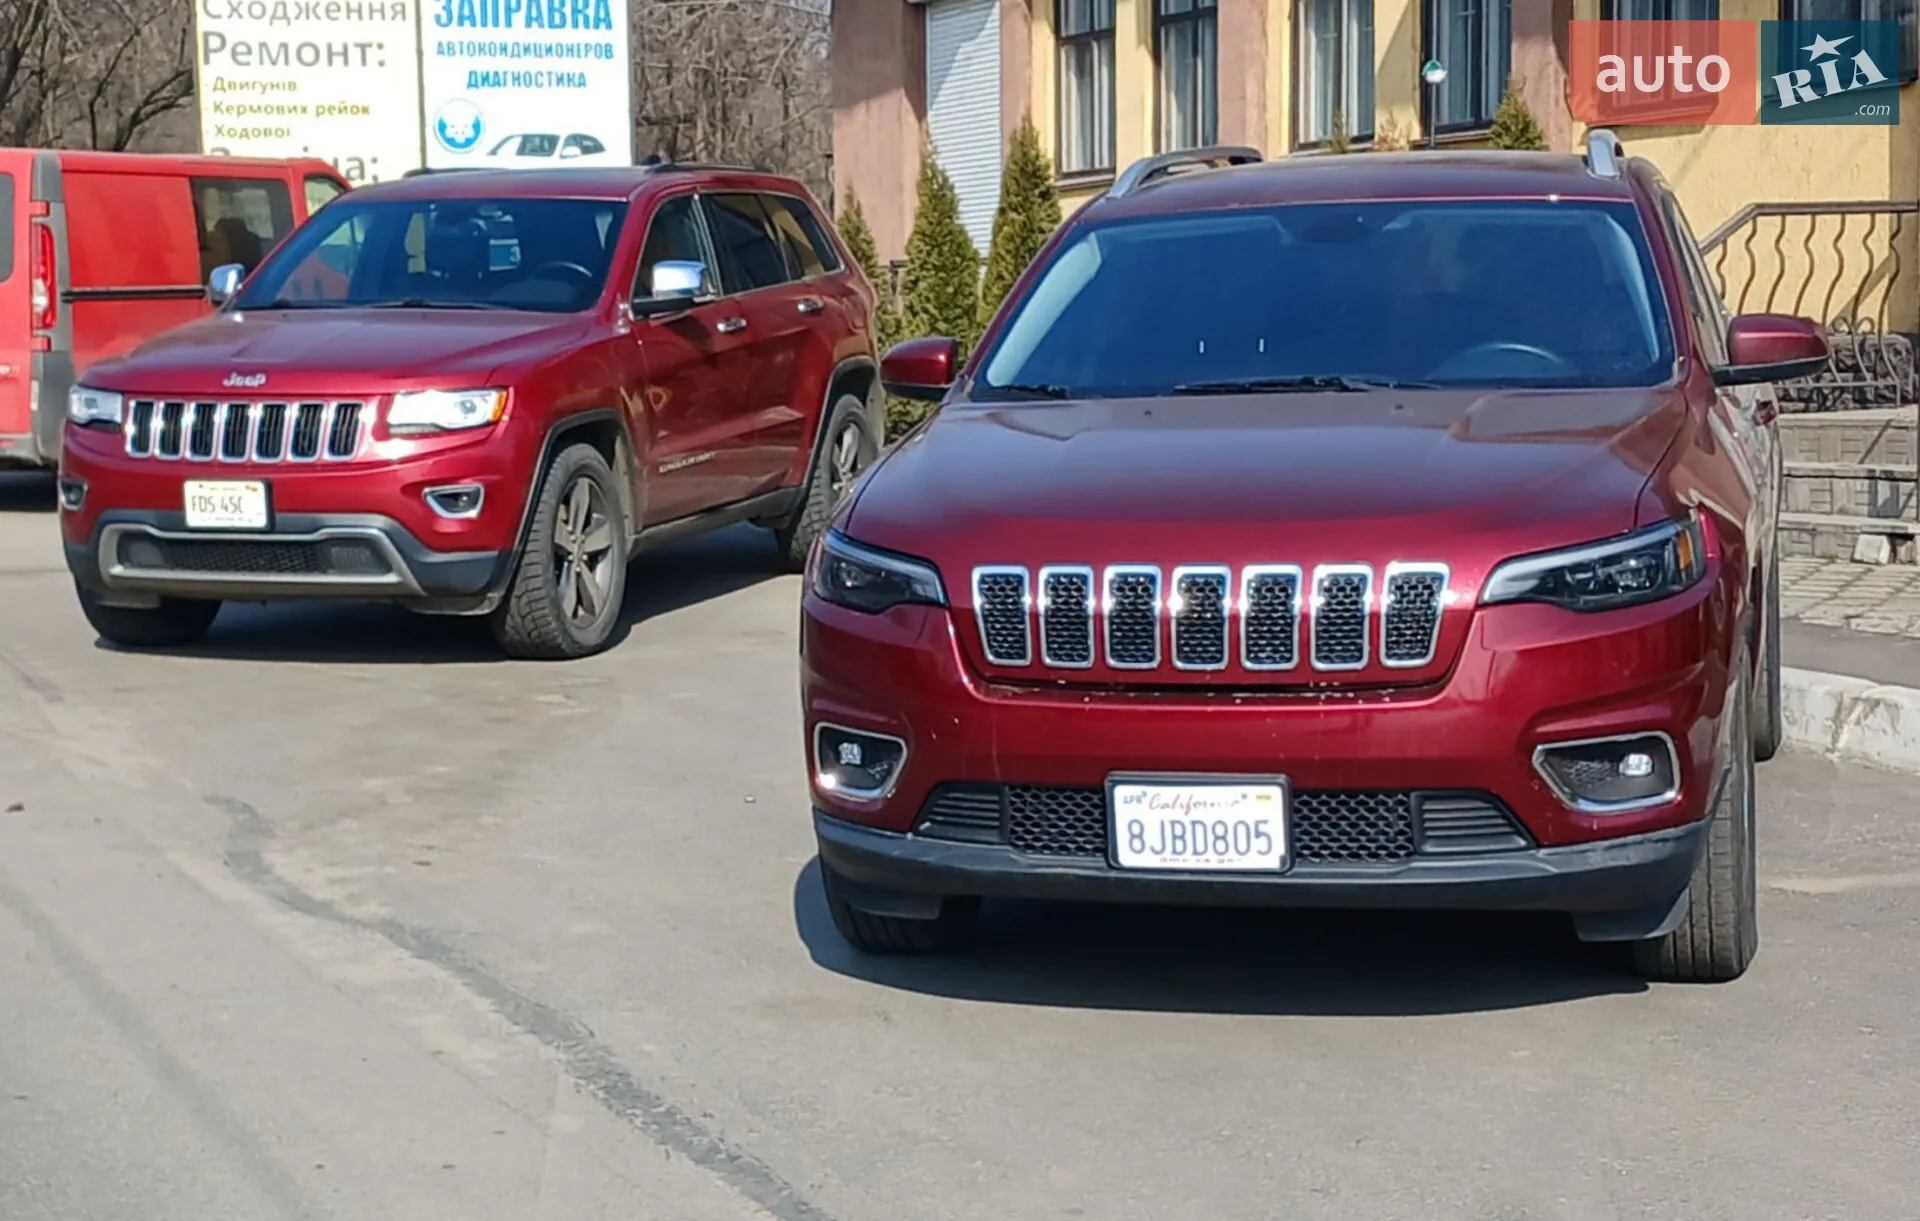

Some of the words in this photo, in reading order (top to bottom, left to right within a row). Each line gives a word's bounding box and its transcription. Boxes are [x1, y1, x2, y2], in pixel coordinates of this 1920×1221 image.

[201, 0, 406, 26] Сходження
[434, 0, 613, 30] ЗАПРАВКА
[202, 30, 385, 67] Ремонт:
[436, 41, 614, 59] АВТОКОНДИЦИОНЕРОВ
[212, 76, 297, 95] Двигунів
[466, 70, 587, 90] ДИАГНОСТИКА
[213, 100, 308, 118] Кермових
[315, 100, 370, 118] рейок
[222, 372, 267, 388] Jeep
[1148, 791, 1242, 817] Califor
[1127, 818, 1273, 856] 8JBD805
